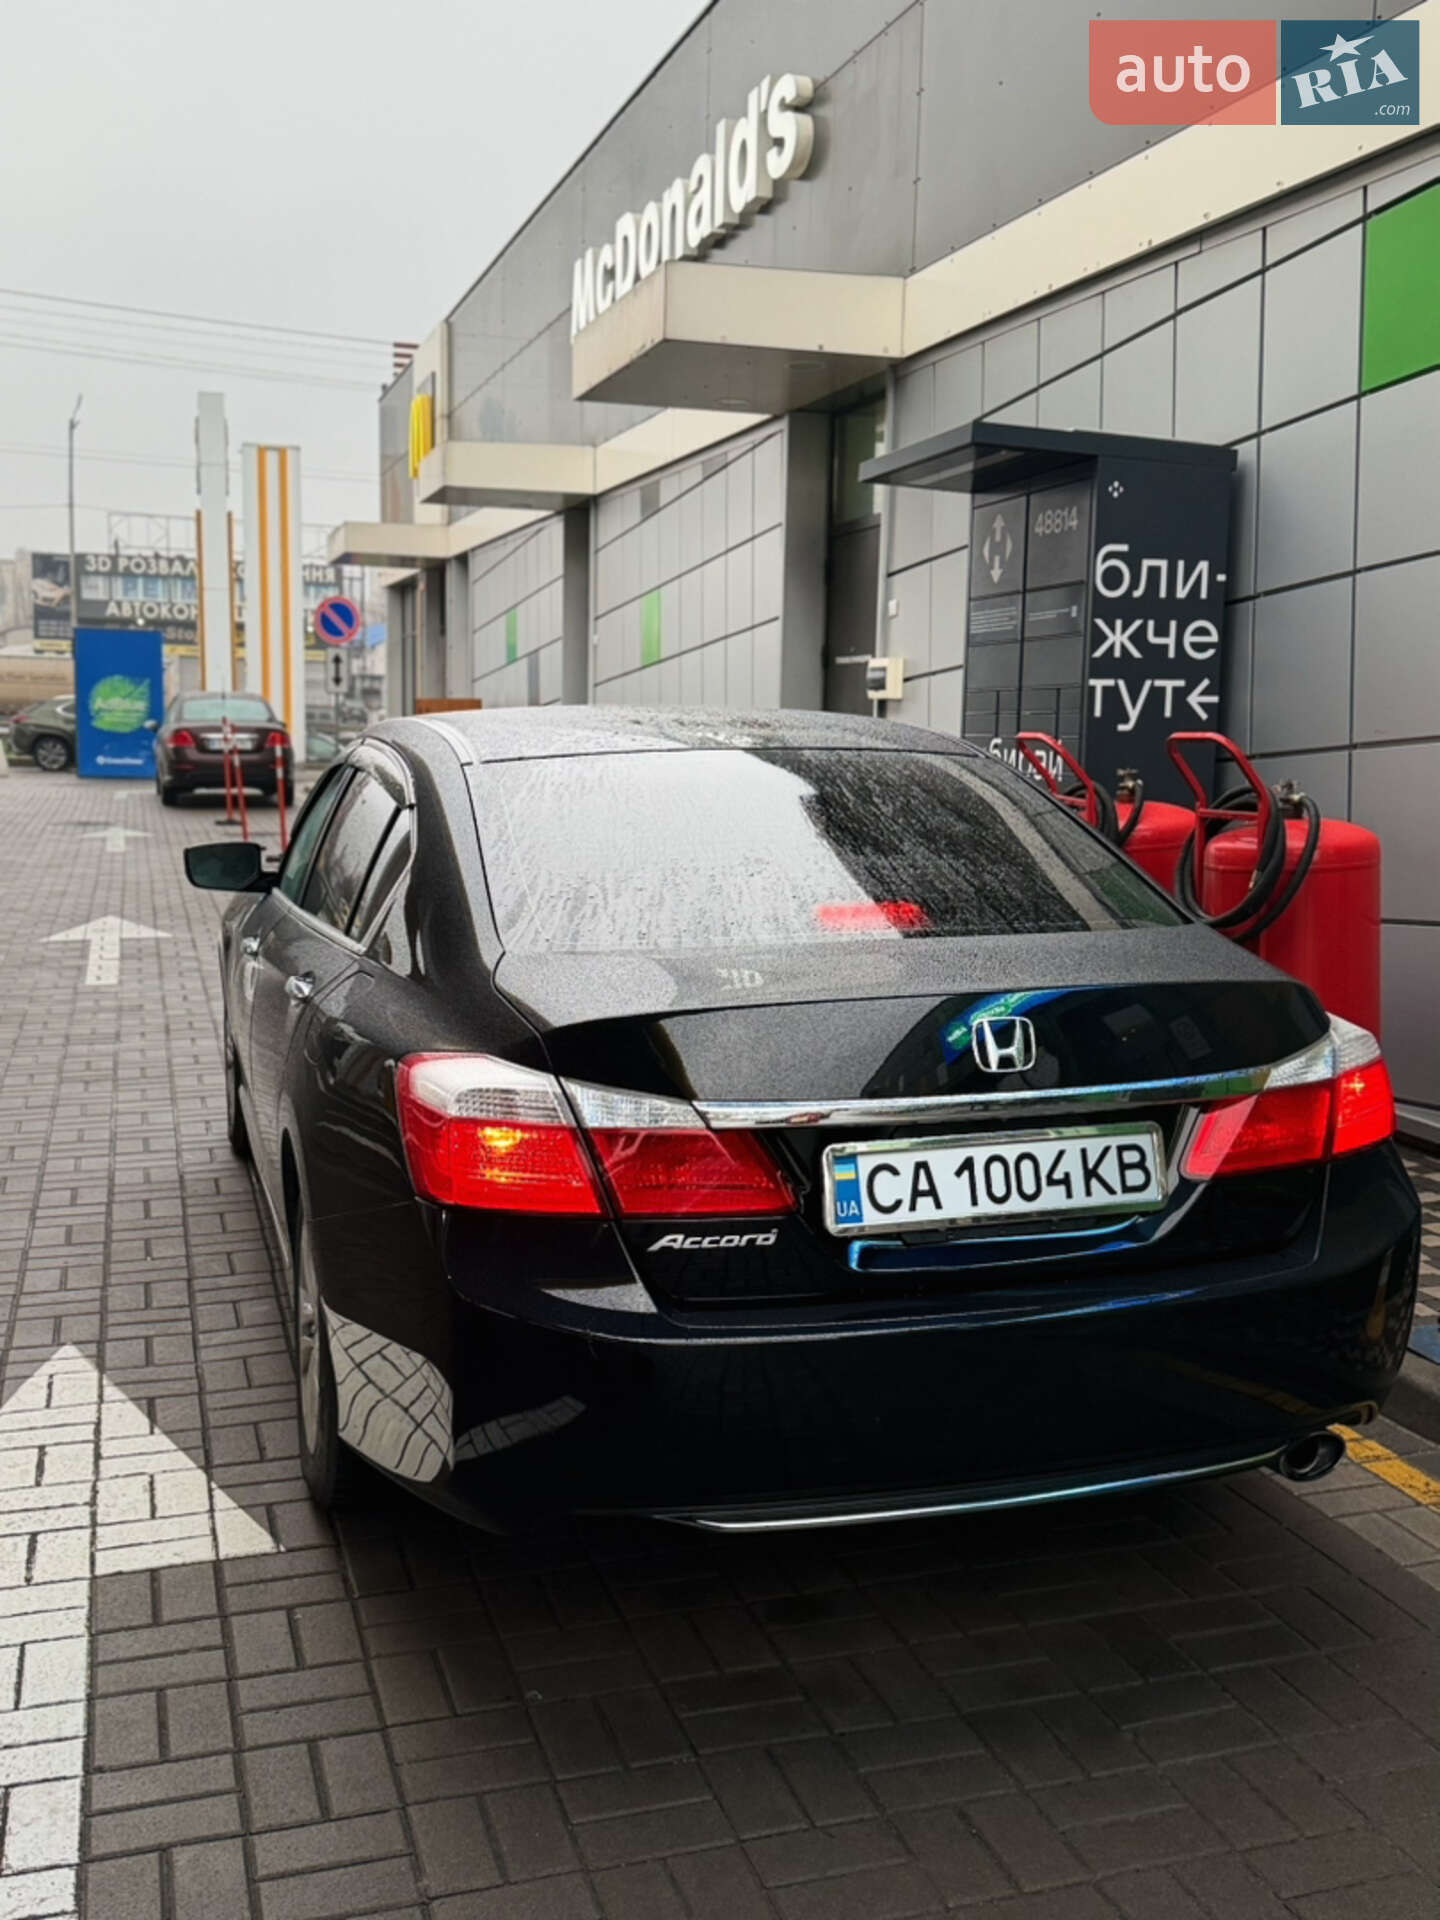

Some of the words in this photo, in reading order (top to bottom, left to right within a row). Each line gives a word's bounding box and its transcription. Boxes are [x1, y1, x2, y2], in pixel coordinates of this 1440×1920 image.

[570, 72, 813, 338] McDonald's
[1034, 506, 1079, 536] 48814
[1092, 618, 1219, 660] жче
[1088, 678, 1185, 732] тут
[836, 1200, 861, 1217] UA
[647, 1228, 779, 1252] Accord
